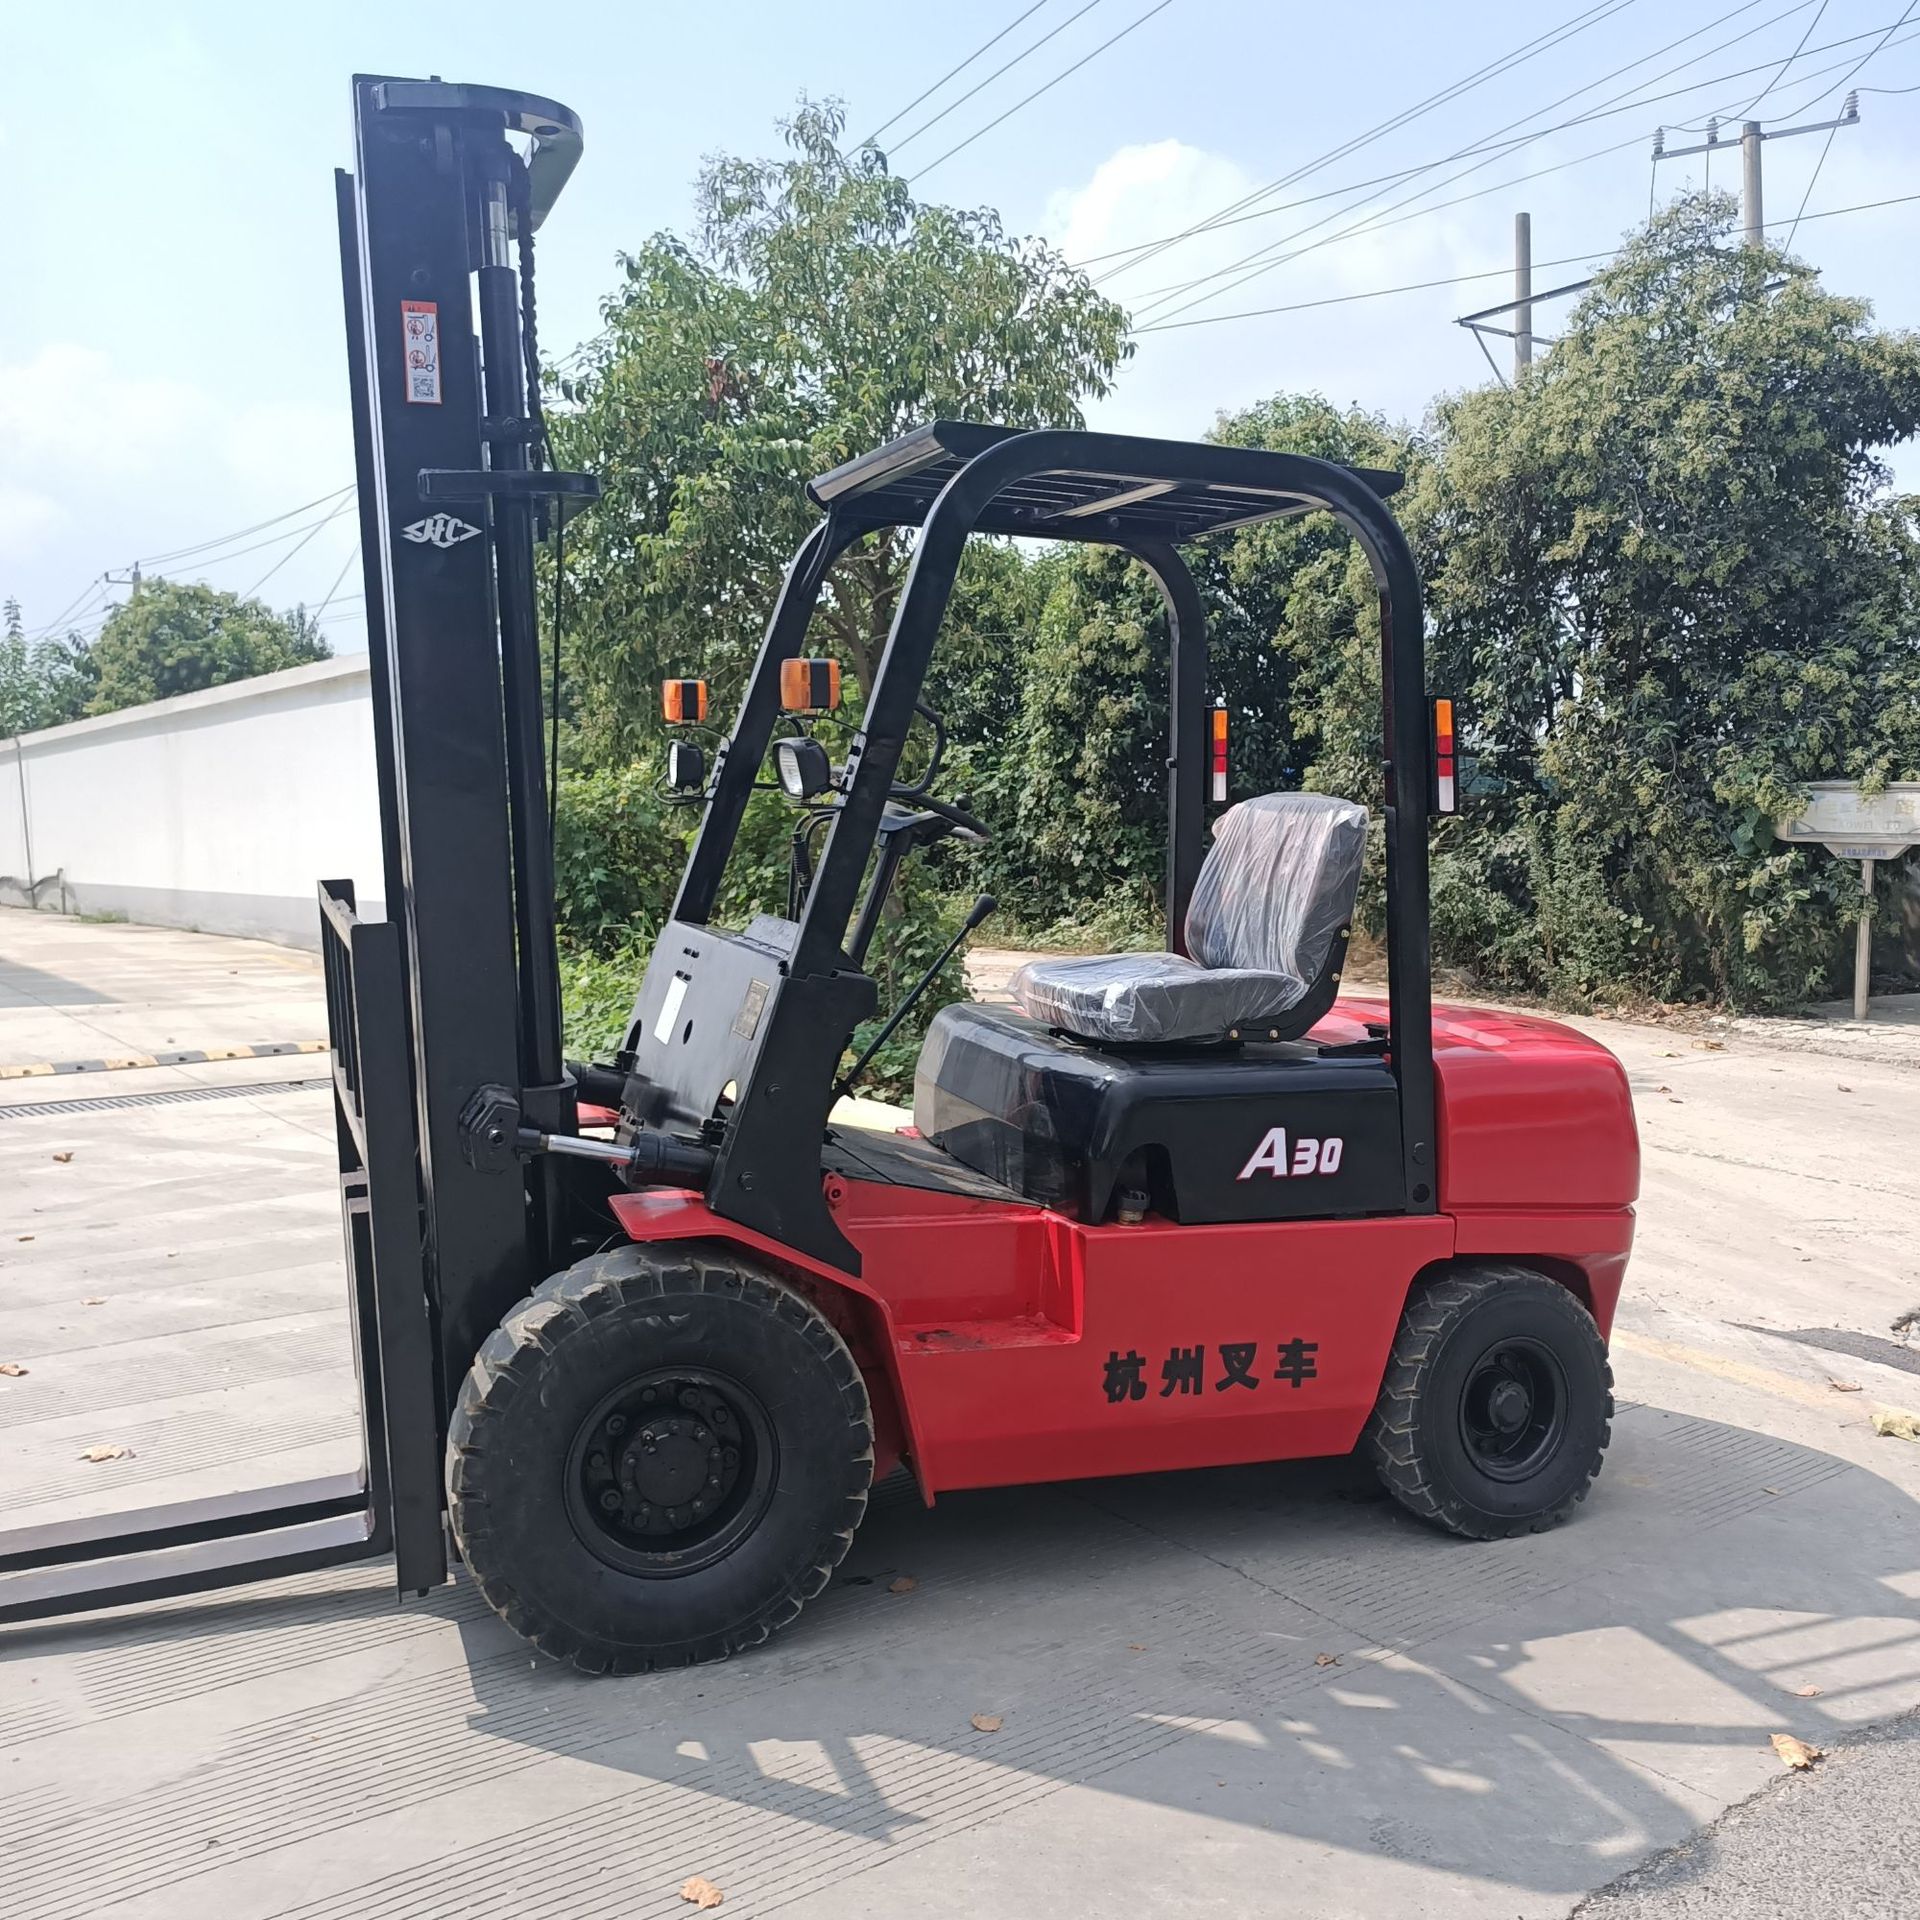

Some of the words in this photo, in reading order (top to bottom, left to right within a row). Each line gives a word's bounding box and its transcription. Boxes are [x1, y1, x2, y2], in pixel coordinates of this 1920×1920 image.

[1236, 1127, 1343, 1181] A30
[1102, 1338, 1319, 1403] 杭州叉车
